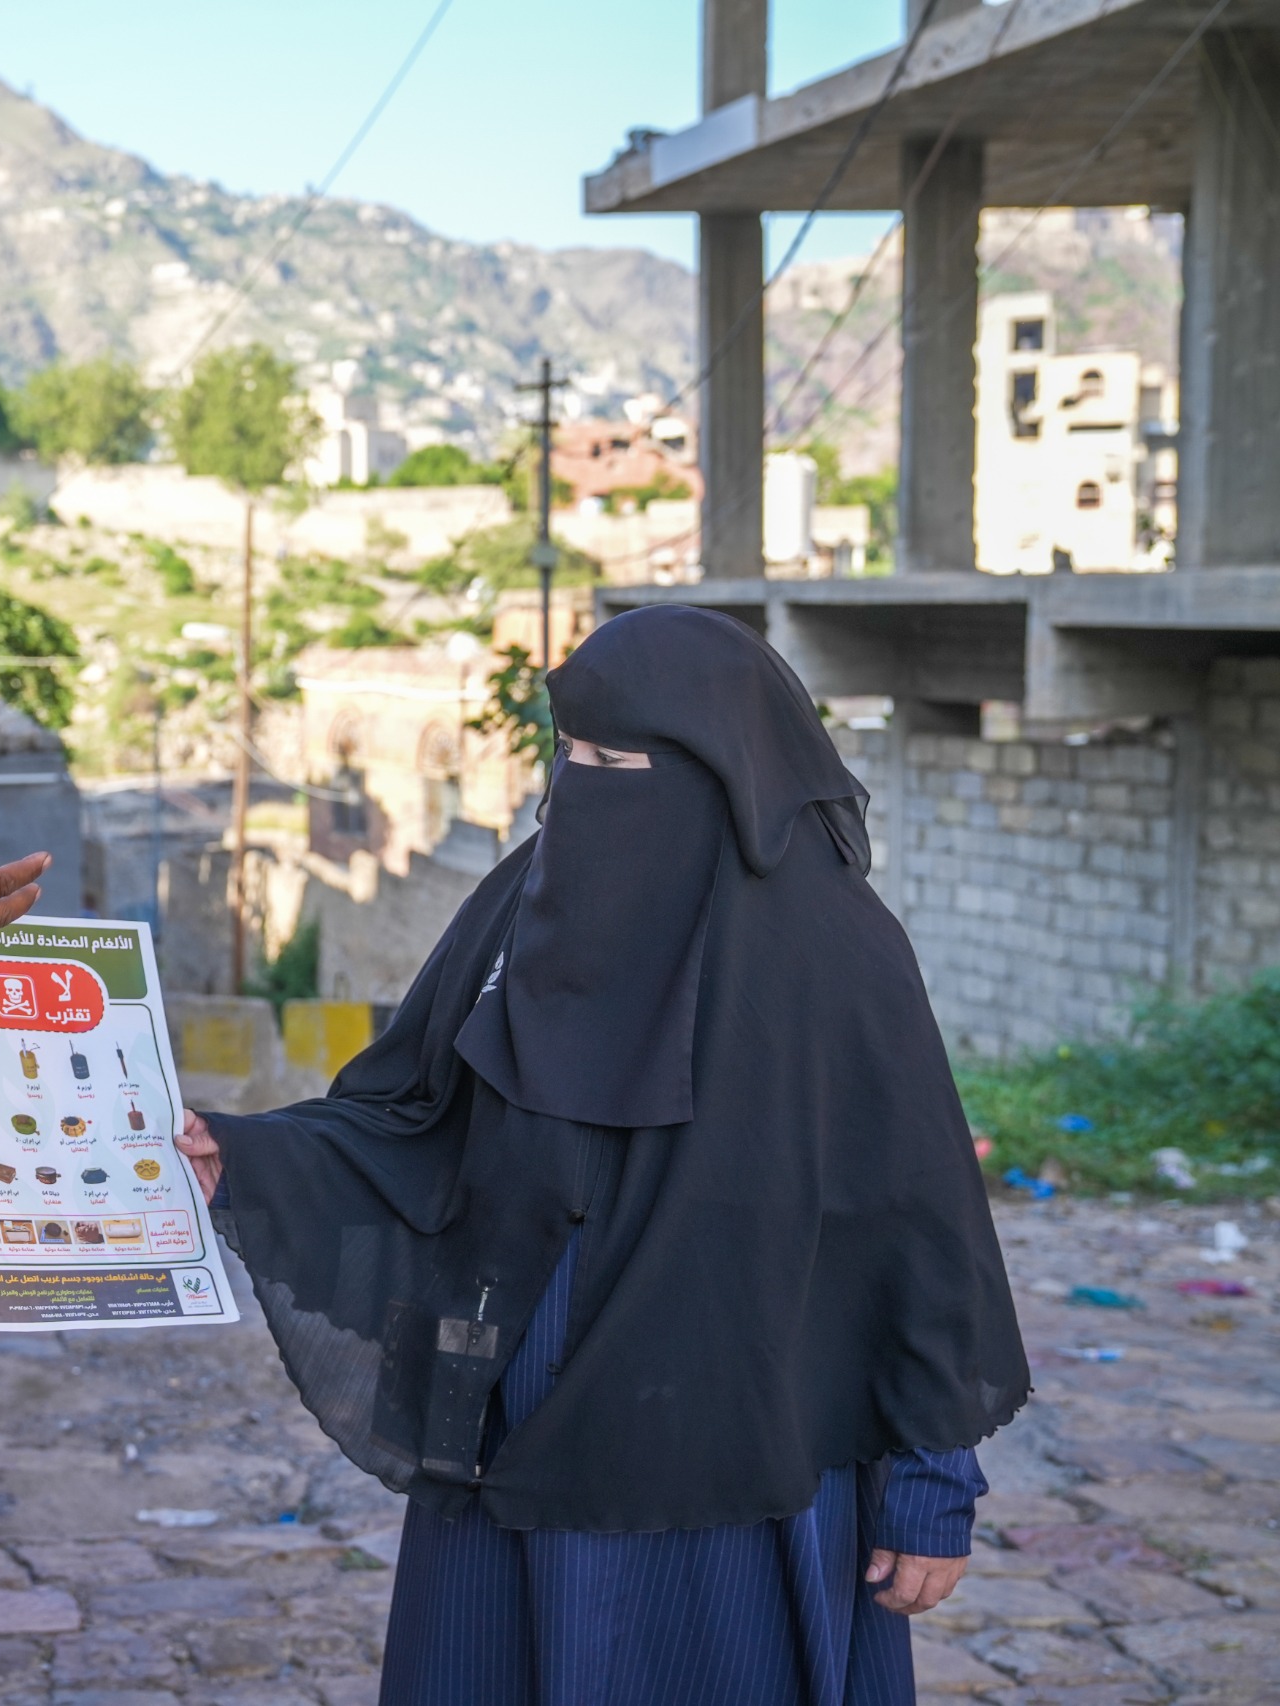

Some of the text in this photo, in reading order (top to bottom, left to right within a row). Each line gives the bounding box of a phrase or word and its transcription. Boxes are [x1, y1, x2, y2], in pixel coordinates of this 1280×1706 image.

[37, 934, 88, 949] المضادة
[91, 936, 133, 953] الألغام
[51, 969, 73, 1002] لا
[45, 1008, 91, 1025] تقترب
[5, 1274, 19, 1284] على
[20, 1274, 39, 1284] اتصل
[40, 1275, 60, 1284] غريب
[61, 1276, 81, 1285] جسم
[104, 1273, 138, 1282] اشتباهك
[155, 1272, 166, 1283] في
